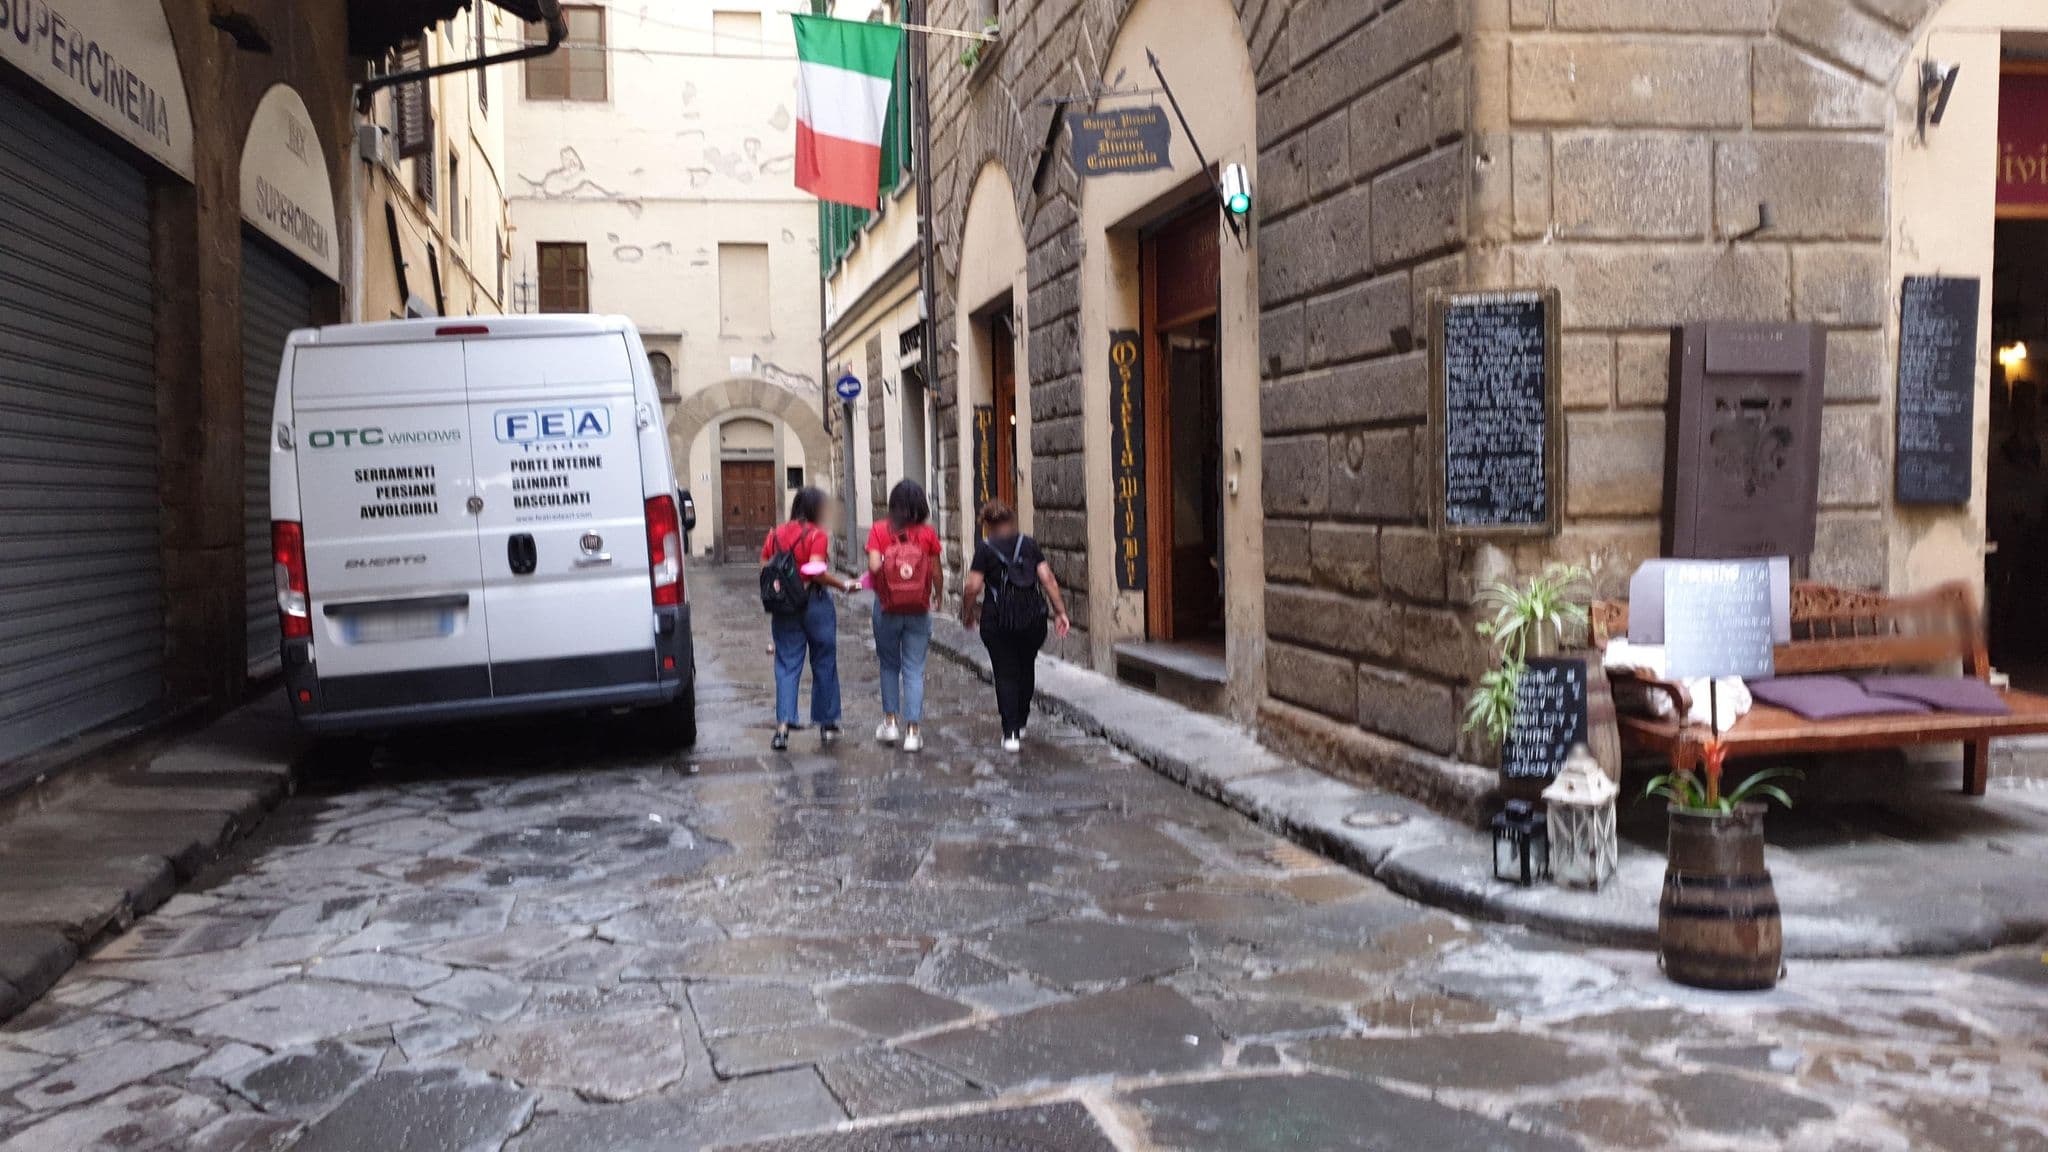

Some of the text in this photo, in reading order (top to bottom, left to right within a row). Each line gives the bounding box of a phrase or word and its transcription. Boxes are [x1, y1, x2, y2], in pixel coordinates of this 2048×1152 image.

[255, 175, 330, 262] SUPERCINEMA
[506, 411, 603, 439] FEA
[308, 426, 462, 448] OTC WINDOWS
[510, 455, 603, 472] PORTE INTERNE
[354, 465, 436, 483] SERRAMENTI
[512, 475, 570, 491] BLINDATE
[376, 483, 437, 500] PERSIANE
[513, 491, 592, 509] BASCULANTI
[360, 501, 439, 520] AVVOLGIBILI
